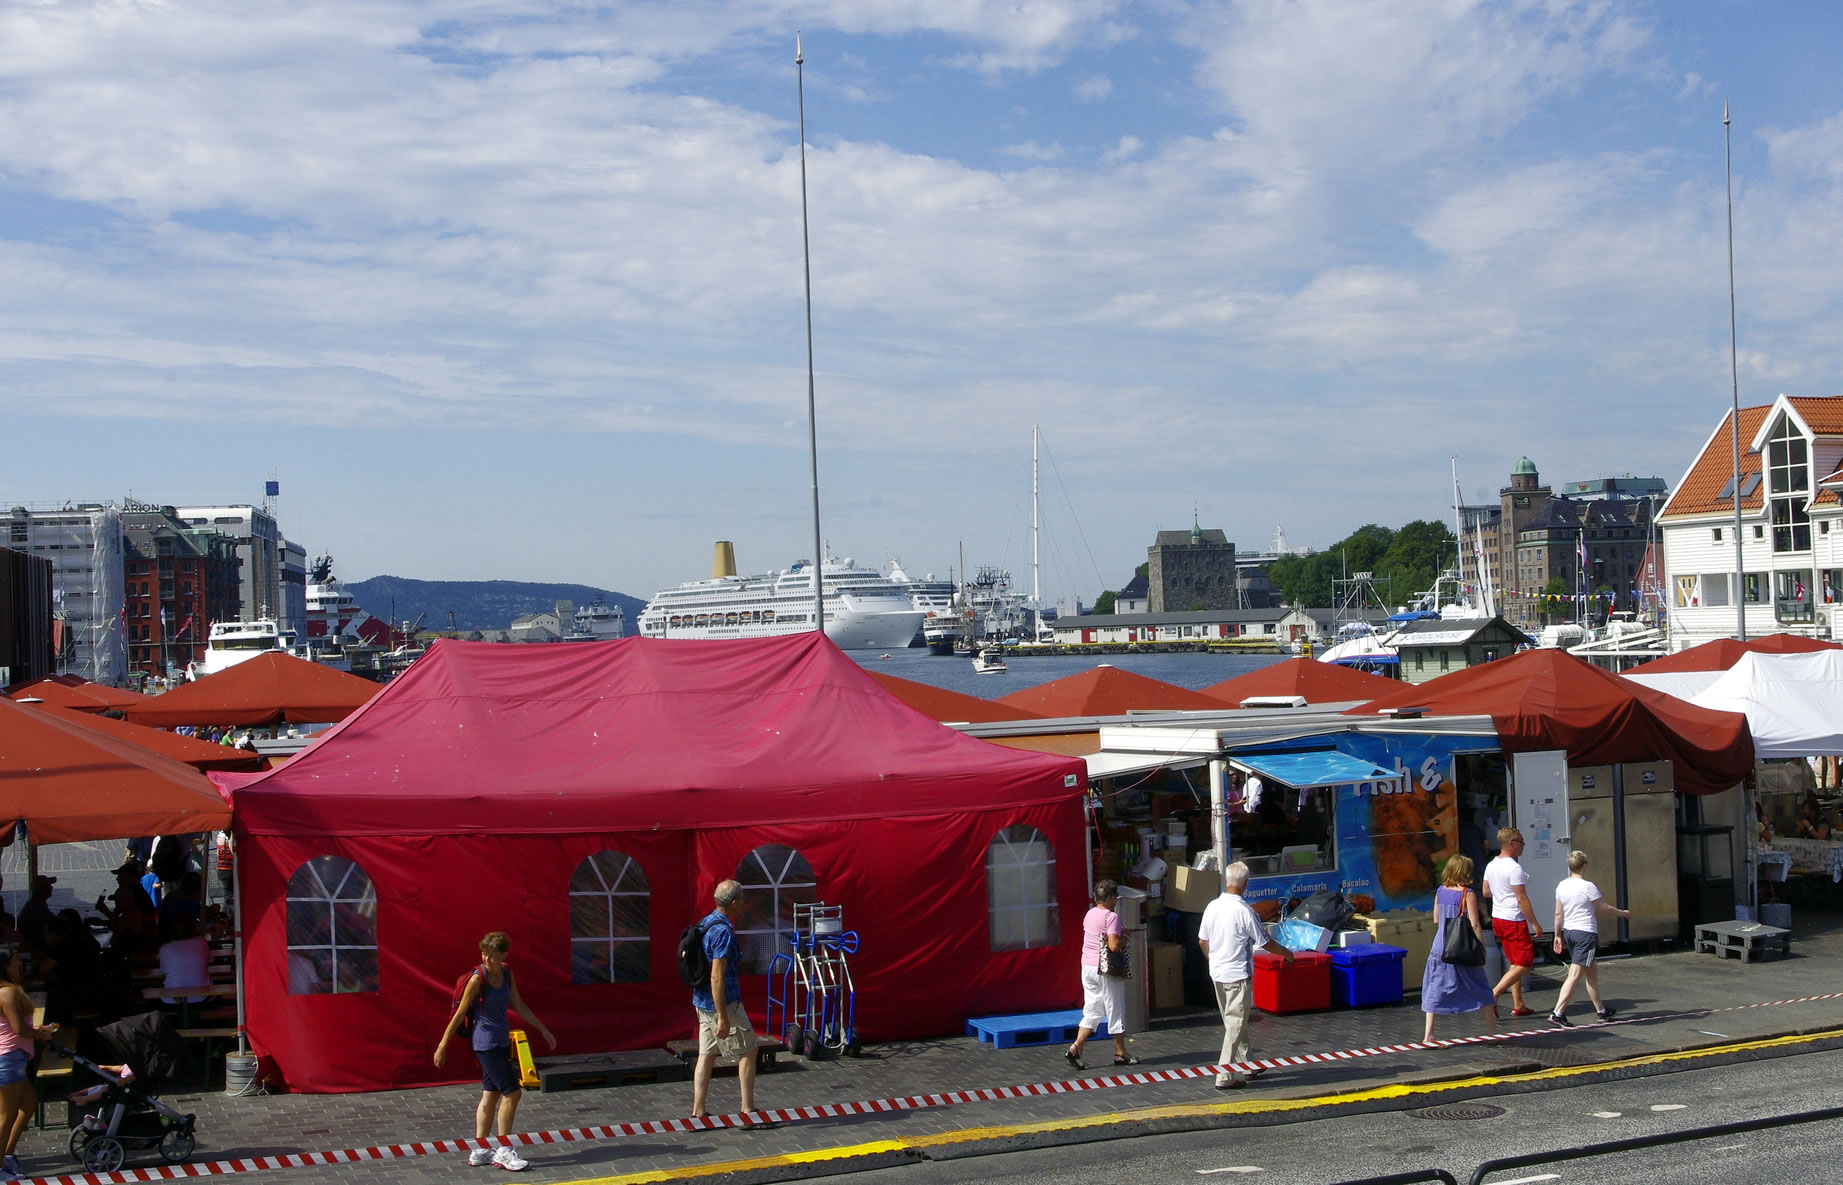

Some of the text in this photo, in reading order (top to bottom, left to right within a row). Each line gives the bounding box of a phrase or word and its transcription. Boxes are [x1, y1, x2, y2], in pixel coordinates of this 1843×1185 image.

[1421, 756, 1442, 791] &
[1292, 882, 1327, 893] Calamaris
[1342, 878, 1369, 888] Bacalao
[1243, 888, 1278, 898] Baguetter
